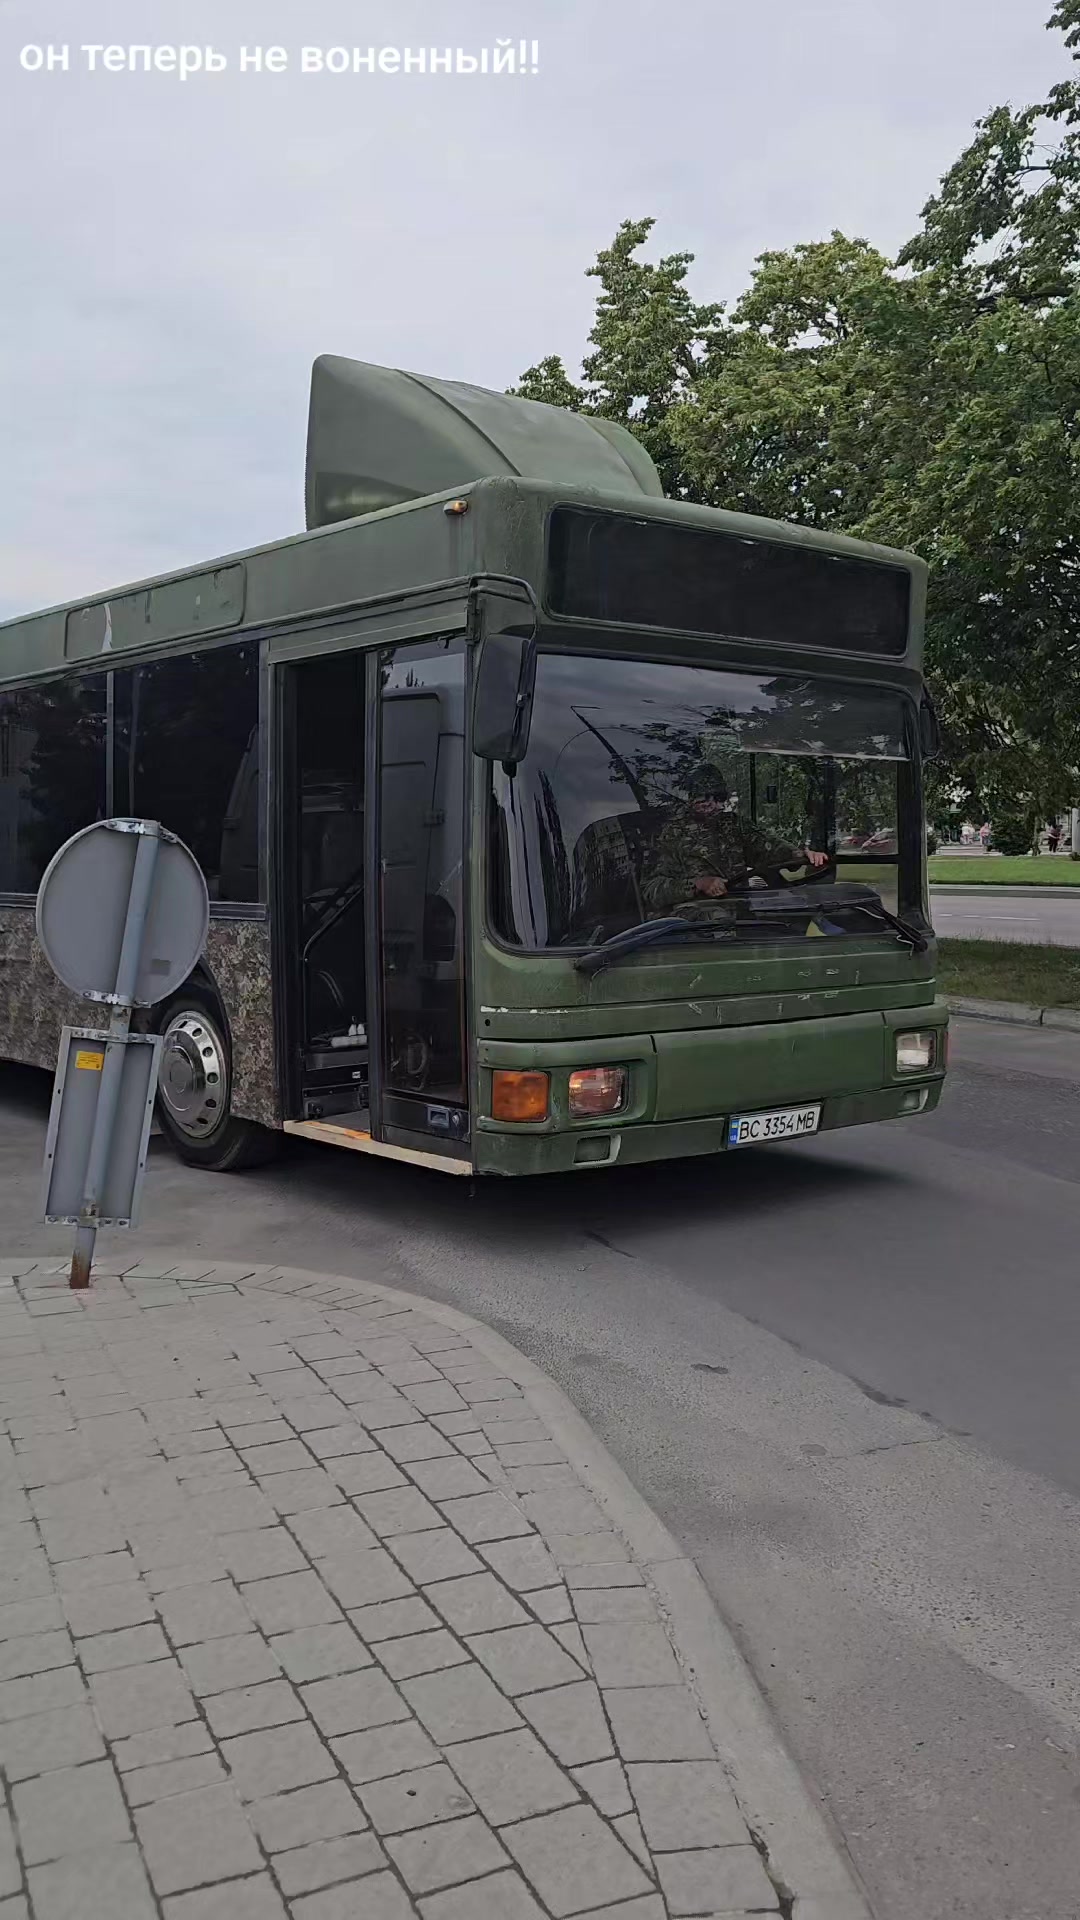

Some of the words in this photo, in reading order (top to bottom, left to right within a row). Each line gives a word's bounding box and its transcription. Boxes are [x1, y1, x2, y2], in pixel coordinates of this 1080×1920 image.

[739, 1120, 761, 1140] BC
[763, 1115, 794, 1136] 3354
[796, 1111, 815, 1131] MB
